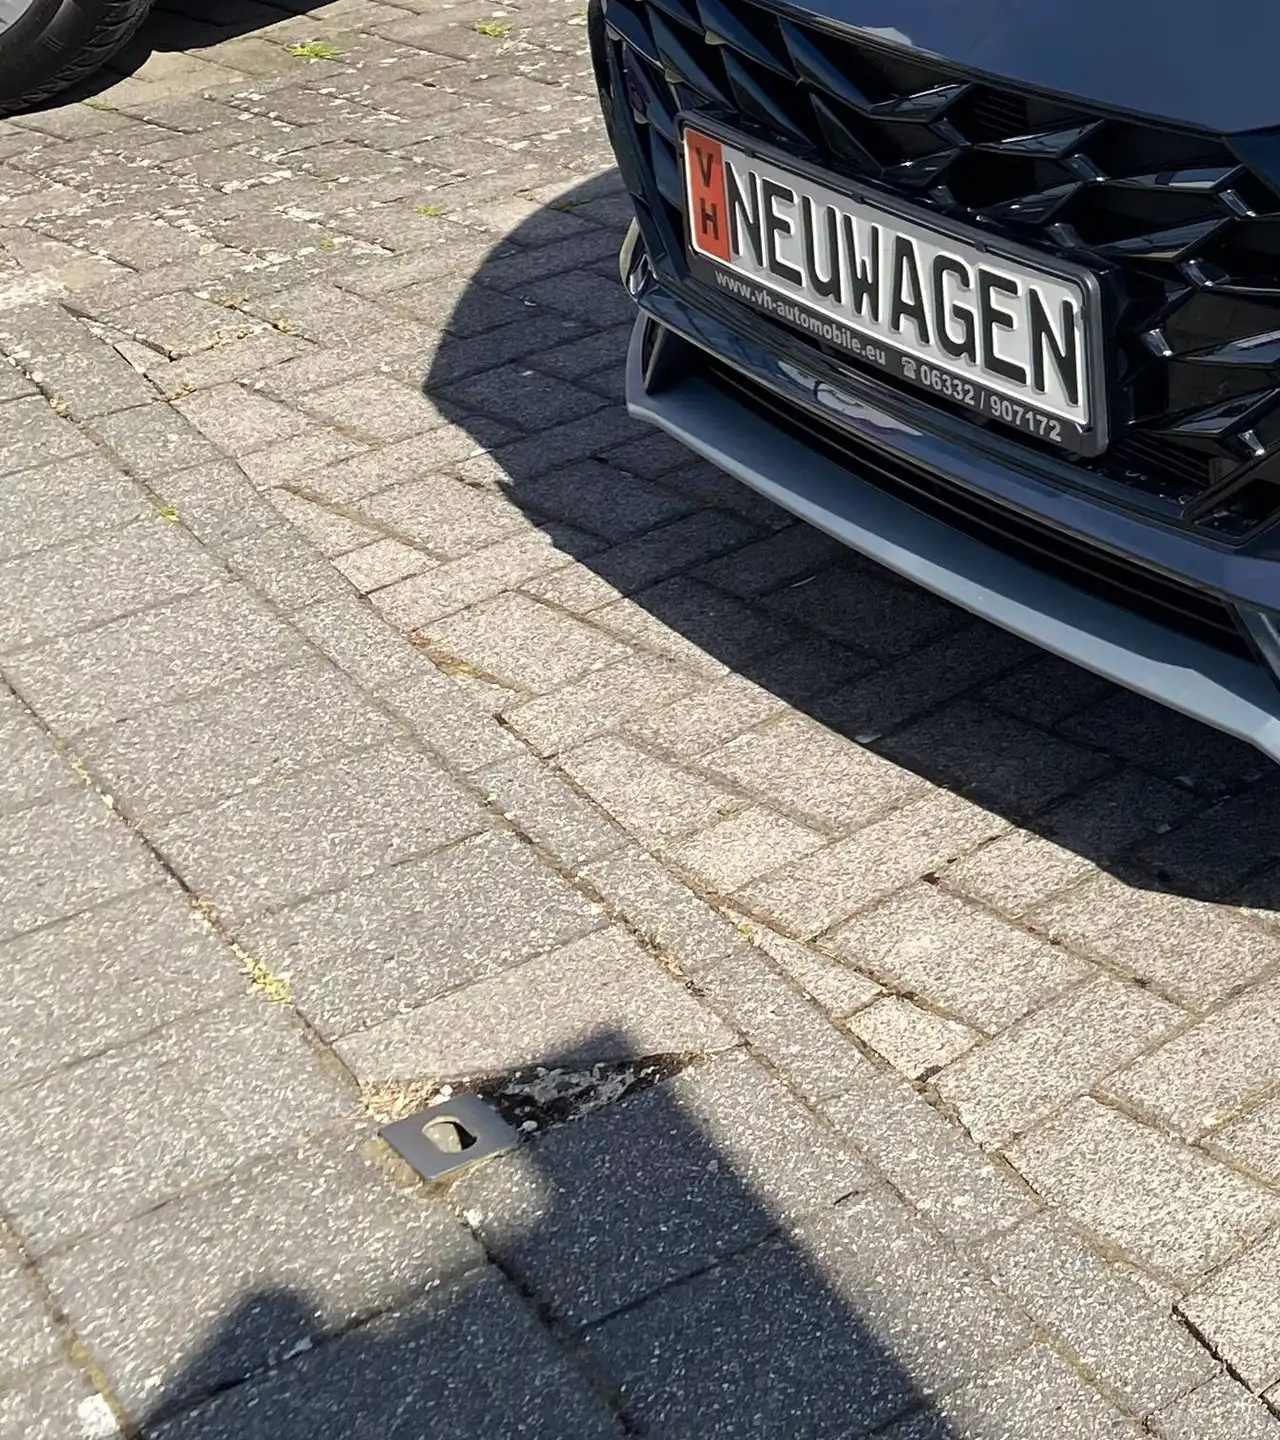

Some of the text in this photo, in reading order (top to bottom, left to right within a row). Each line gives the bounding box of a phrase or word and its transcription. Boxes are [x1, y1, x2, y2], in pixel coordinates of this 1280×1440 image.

[714, 270, 887, 366] www.vh-automobile.eu
[920, 364, 975, 406] 06332
[989, 395, 1062, 442] 907172
[725, 160, 1081, 407] NEUWAGEN
